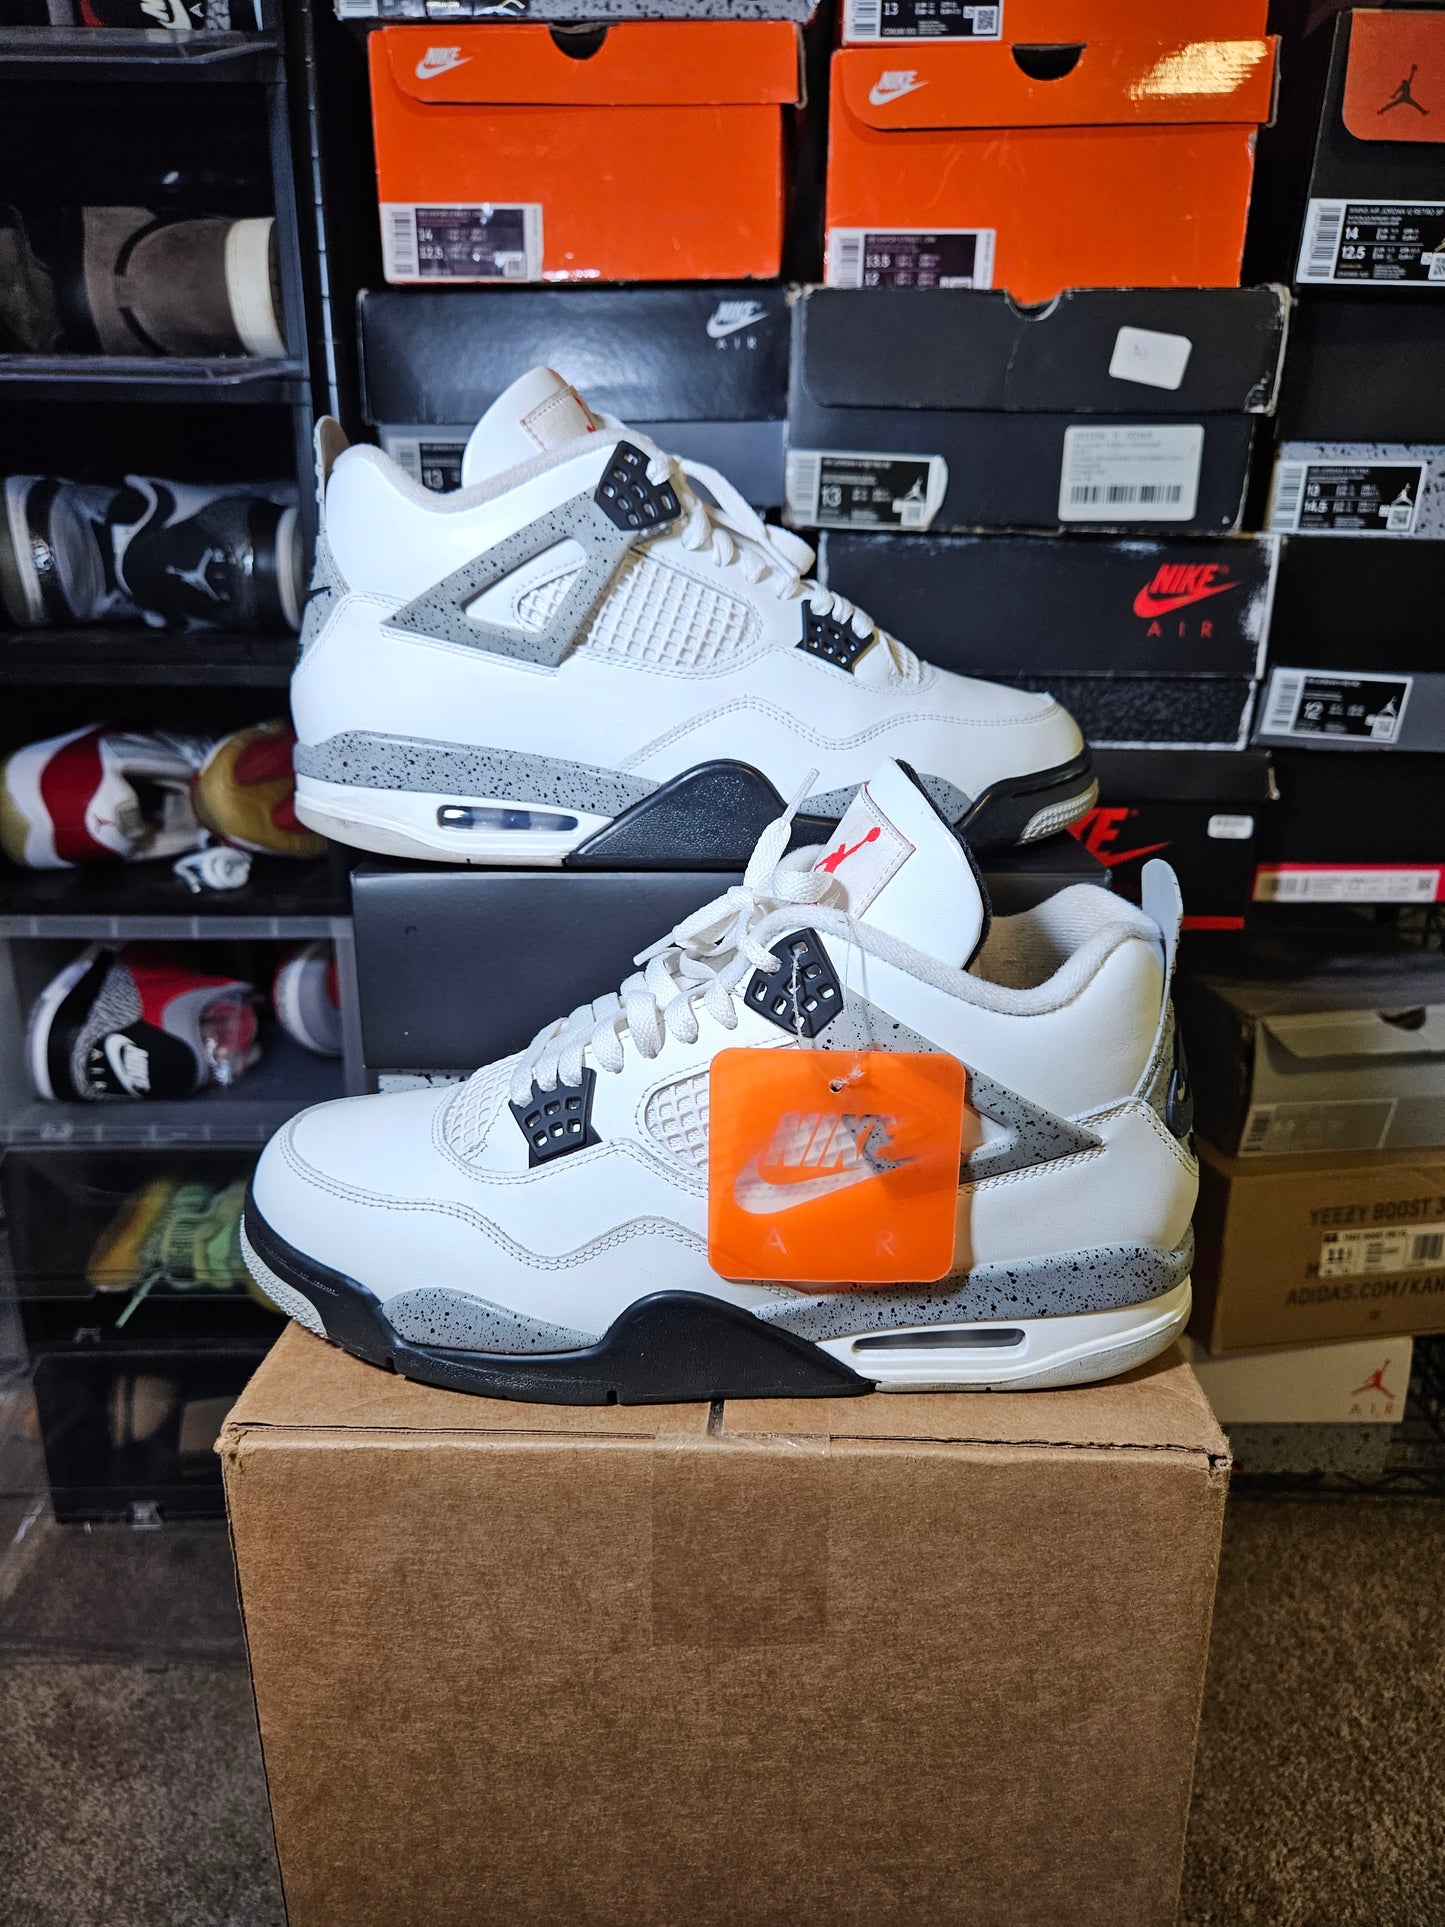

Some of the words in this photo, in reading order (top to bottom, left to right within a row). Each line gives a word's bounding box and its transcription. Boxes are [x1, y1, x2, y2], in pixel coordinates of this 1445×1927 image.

[424, 46, 463, 66] NIKE
[879, 70, 919, 91] NIKE
[1345, 226, 1359, 240] 14
[1341, 246, 1367, 260] 12.5
[716, 300, 763, 323] NIKE
[715, 336, 758, 351] AIR
[1146, 620, 1214, 638] AIR
[1304, 701, 1325, 721] 12
[764, 1113, 900, 1168] NIKE
[1311, 1204, 1368, 1226] YEEZY
[1373, 1198, 1430, 1221] BOOST
